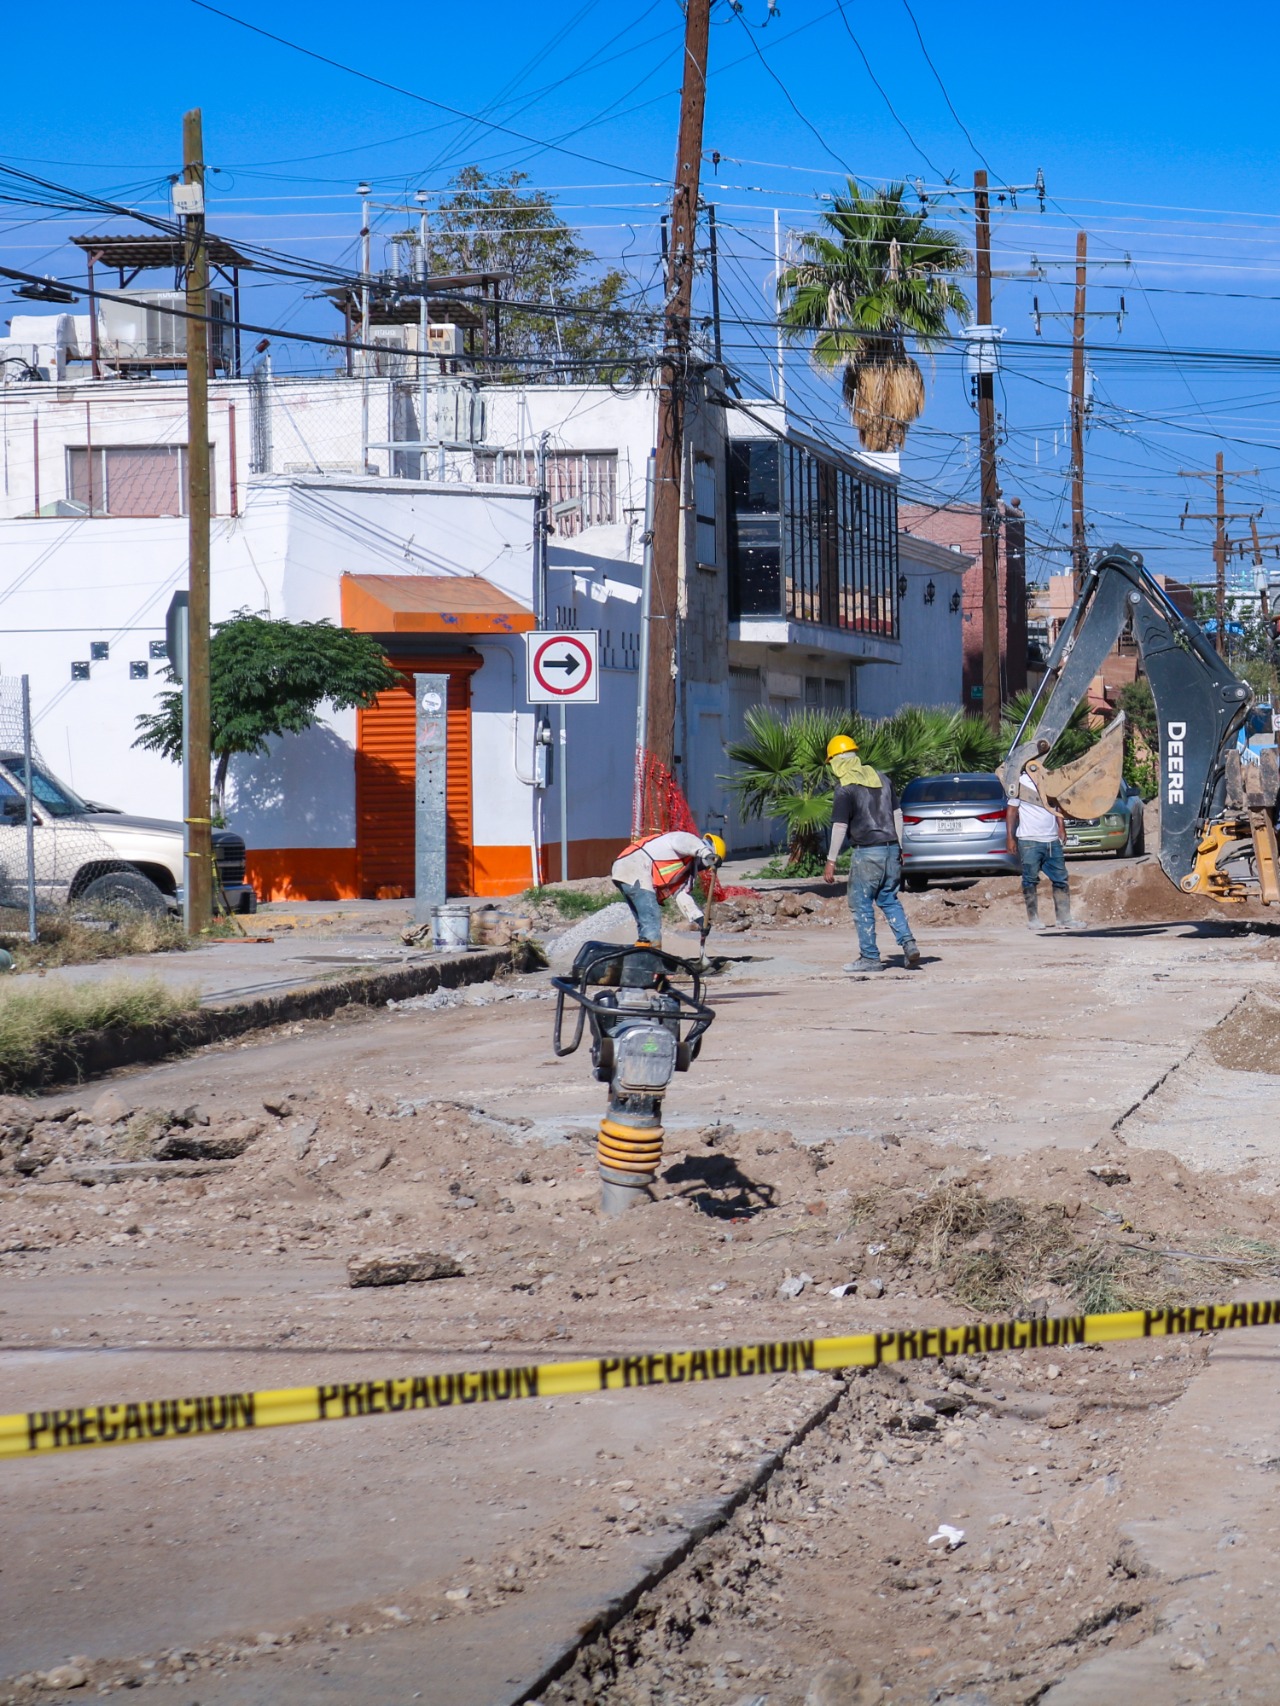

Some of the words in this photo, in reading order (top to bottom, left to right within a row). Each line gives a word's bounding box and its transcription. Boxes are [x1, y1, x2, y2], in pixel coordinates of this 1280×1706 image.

[1168, 721, 1184, 805] DEERE
[599, 1340, 815, 1390] PRECAUCION
[874, 1316, 1086, 1362] PRECAUCION
[317, 1366, 539, 1420] PRECAUCION
[27, 1392, 254, 1449] PRECAUCION
